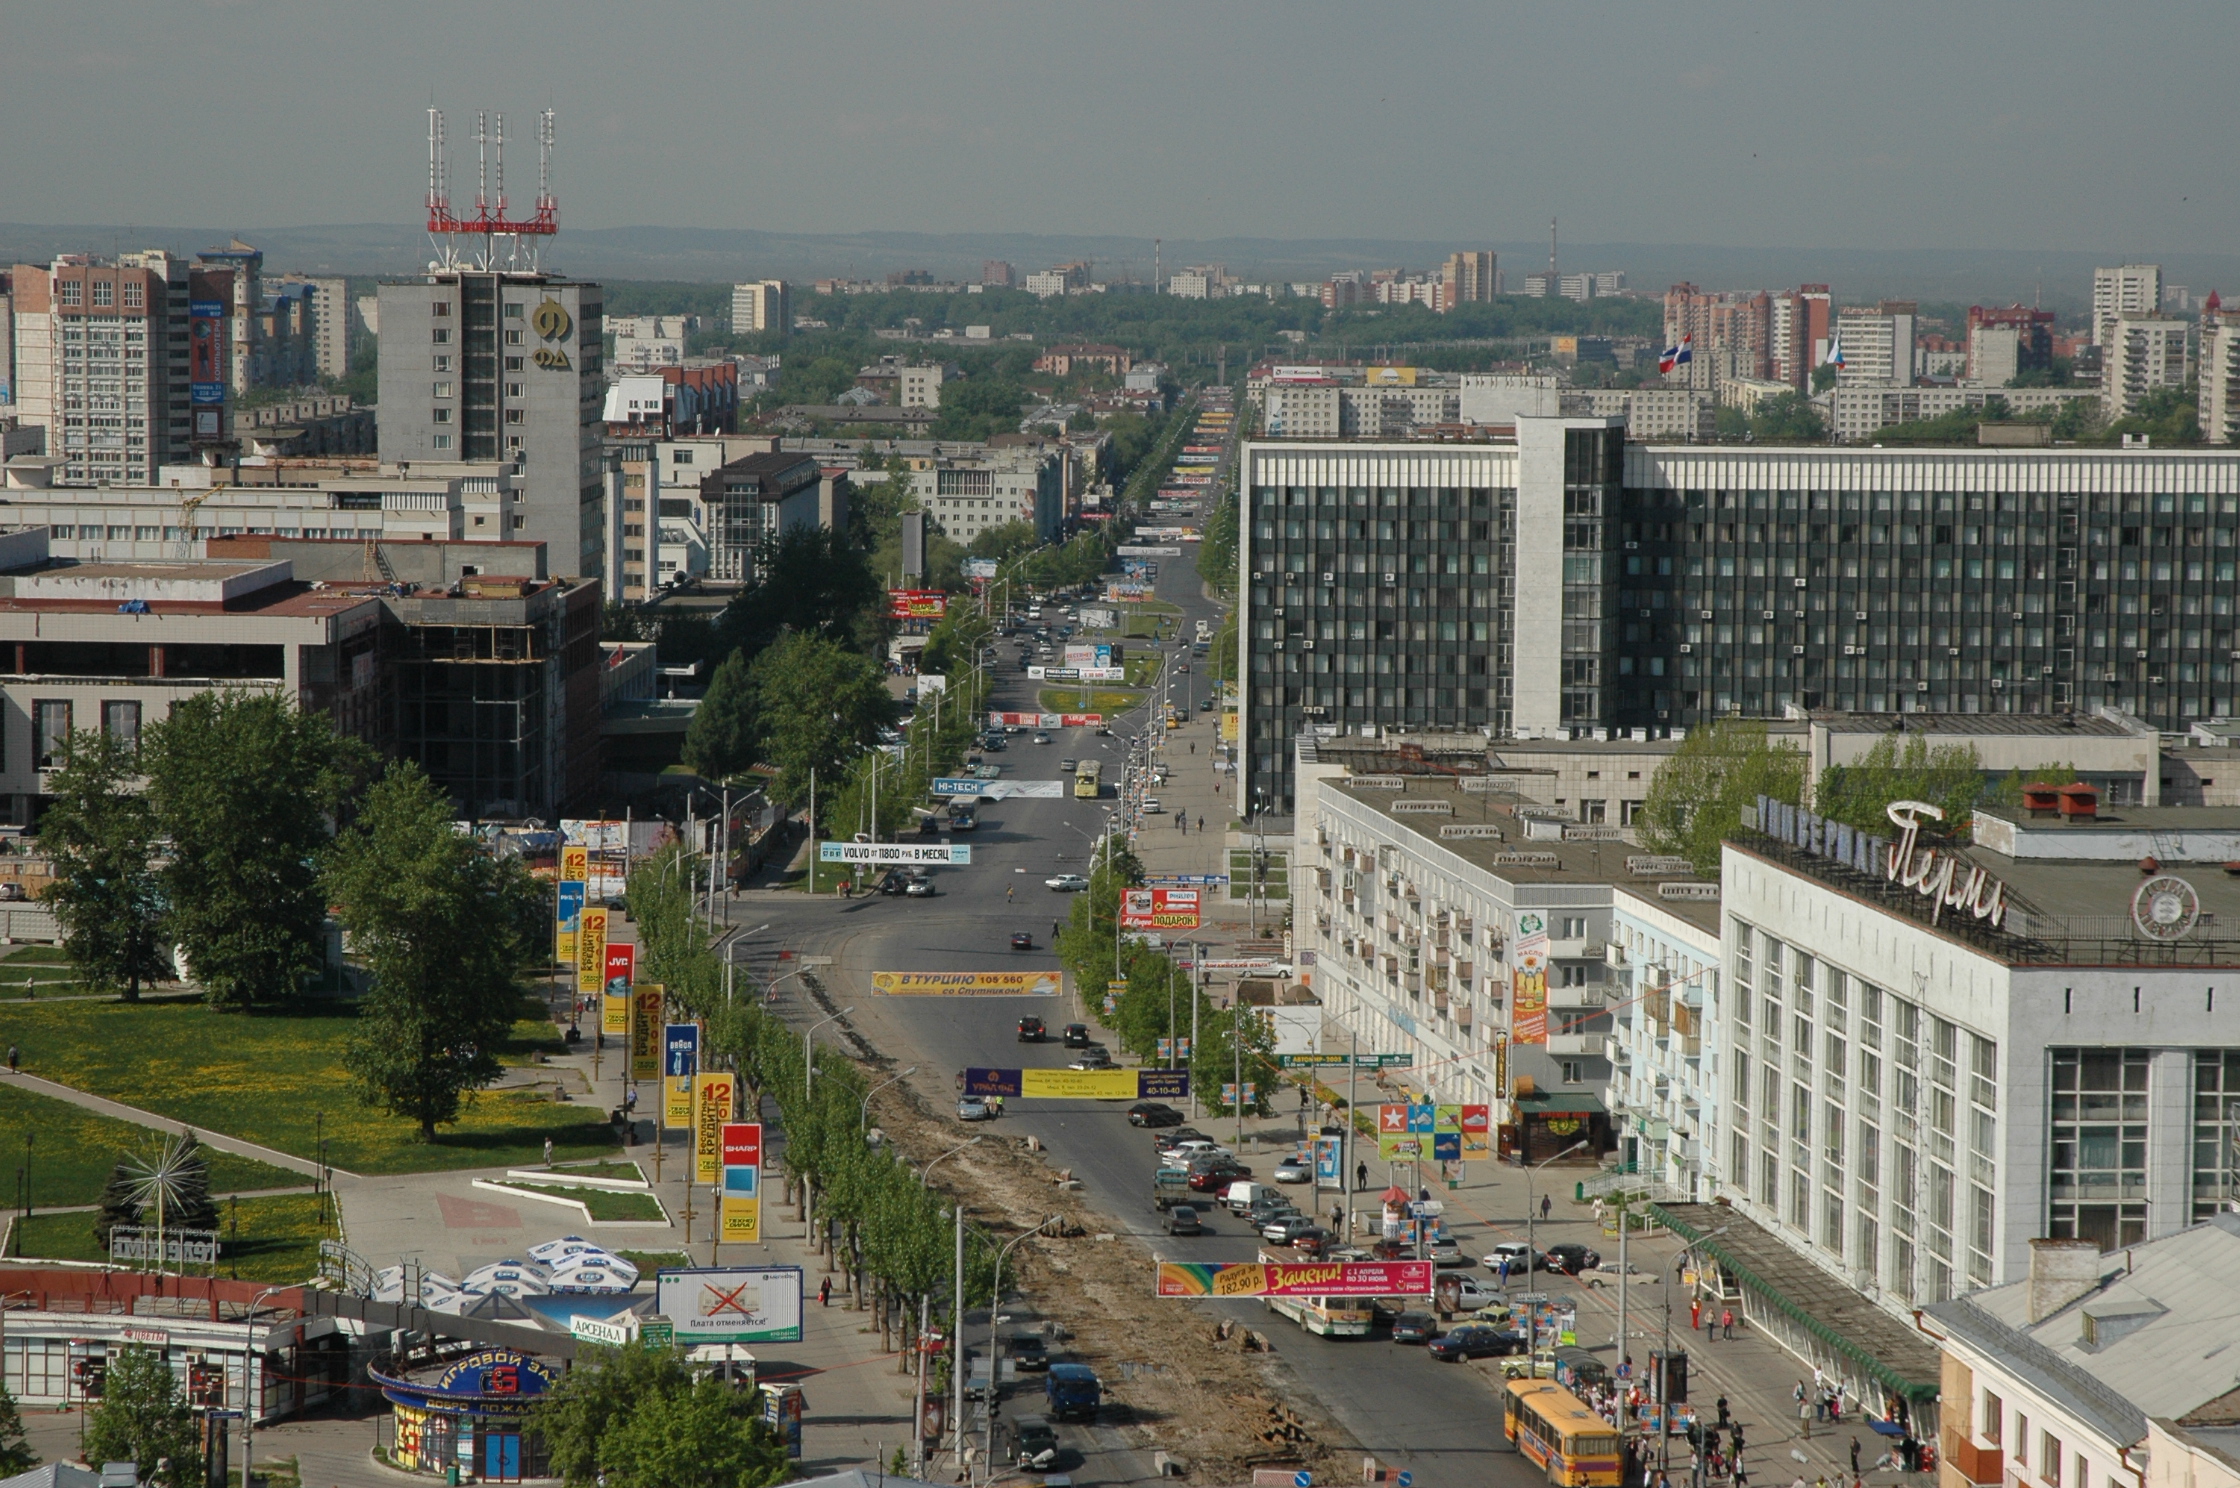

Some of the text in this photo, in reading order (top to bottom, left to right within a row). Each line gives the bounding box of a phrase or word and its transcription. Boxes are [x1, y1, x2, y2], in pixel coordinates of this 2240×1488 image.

[214, 319, 222, 382] КОМПЬЮТЕРЫ
[938, 782, 978, 791] HI-TECH
[1757, 793, 1883, 877] УНИВЕРМАГ
[567, 853, 585, 867] 12
[844, 847, 869, 858] VOLVO
[879, 848, 900, 859] 11800
[915, 850, 920, 860] В
[922, 849, 949, 861] МЕСЯЦ
[585, 916, 605, 930] 12
[1153, 915, 1197, 926] ПОДАРОК!
[1517, 949, 1543, 958] МАСЛО
[609, 957, 628, 965] JVC
[901, 976, 910, 984] В
[915, 975, 975, 985] ТУРЦИЮ
[960, 987, 1024, 996] Спутником!
[637, 993, 661, 1010] 12
[640, 1013, 648, 1056] КРЕДИТ
[704, 1082, 730, 1103] 12
[1147, 1086, 1180, 1095] 40-10-40
[706, 1107, 715, 1156] КРЕДИТ
[1271, 1263, 1342, 1291] Зацени!
[1221, 1279, 1251, 1295] 182.90
[691, 1319, 714, 1327] Плата
[134, 1330, 165, 1341] ЦВЕТЫ
[574, 1320, 622, 1342] АРСЕНАЛ
[439, 1351, 522, 1390] ИГРОВОЙ
[425, 1399, 470, 1411] ДОБРО
